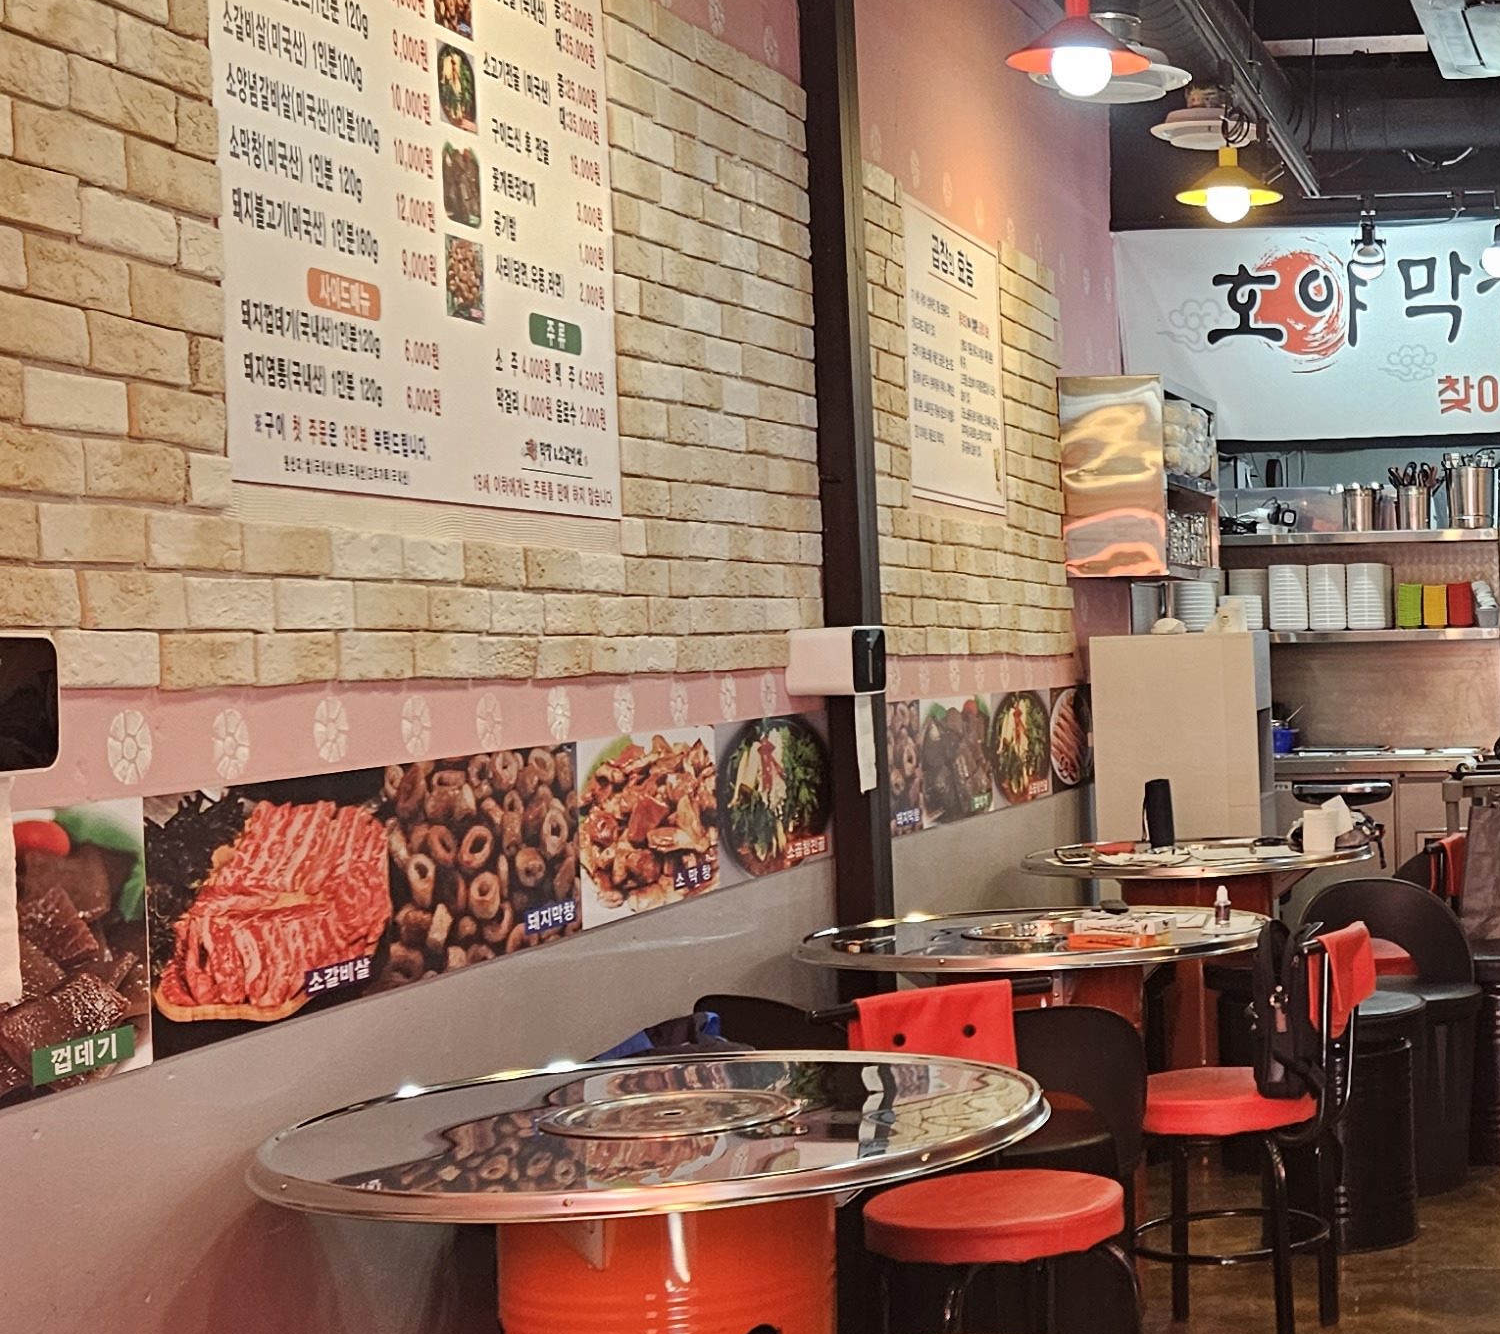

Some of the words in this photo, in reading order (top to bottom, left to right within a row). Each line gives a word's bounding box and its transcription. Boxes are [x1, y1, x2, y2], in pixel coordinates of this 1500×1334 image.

[391, 25, 428, 73] 9,000원
[390, 78, 431, 126] 10,000원
[337, 163, 363, 204] 120g
[395, 188, 436, 234] 12,000원
[578, 279, 605, 311] 2,000원
[545, 318, 566, 350] 주류
[404, 335, 440, 371] 6,000원
[521, 353, 551, 384] 4,000원
[359, 376, 383, 407] 120g
[405, 383, 442, 417] 6,000원
[522, 392, 552, 422] 4,000원
[579, 403, 606, 432] 2,000원
[786, 837, 827, 860] 소곱창전골
[526, 901, 577, 932] 돼지막창
[307, 956, 371, 994] 소갈비살
[50, 1032, 118, 1076] 껍데기
